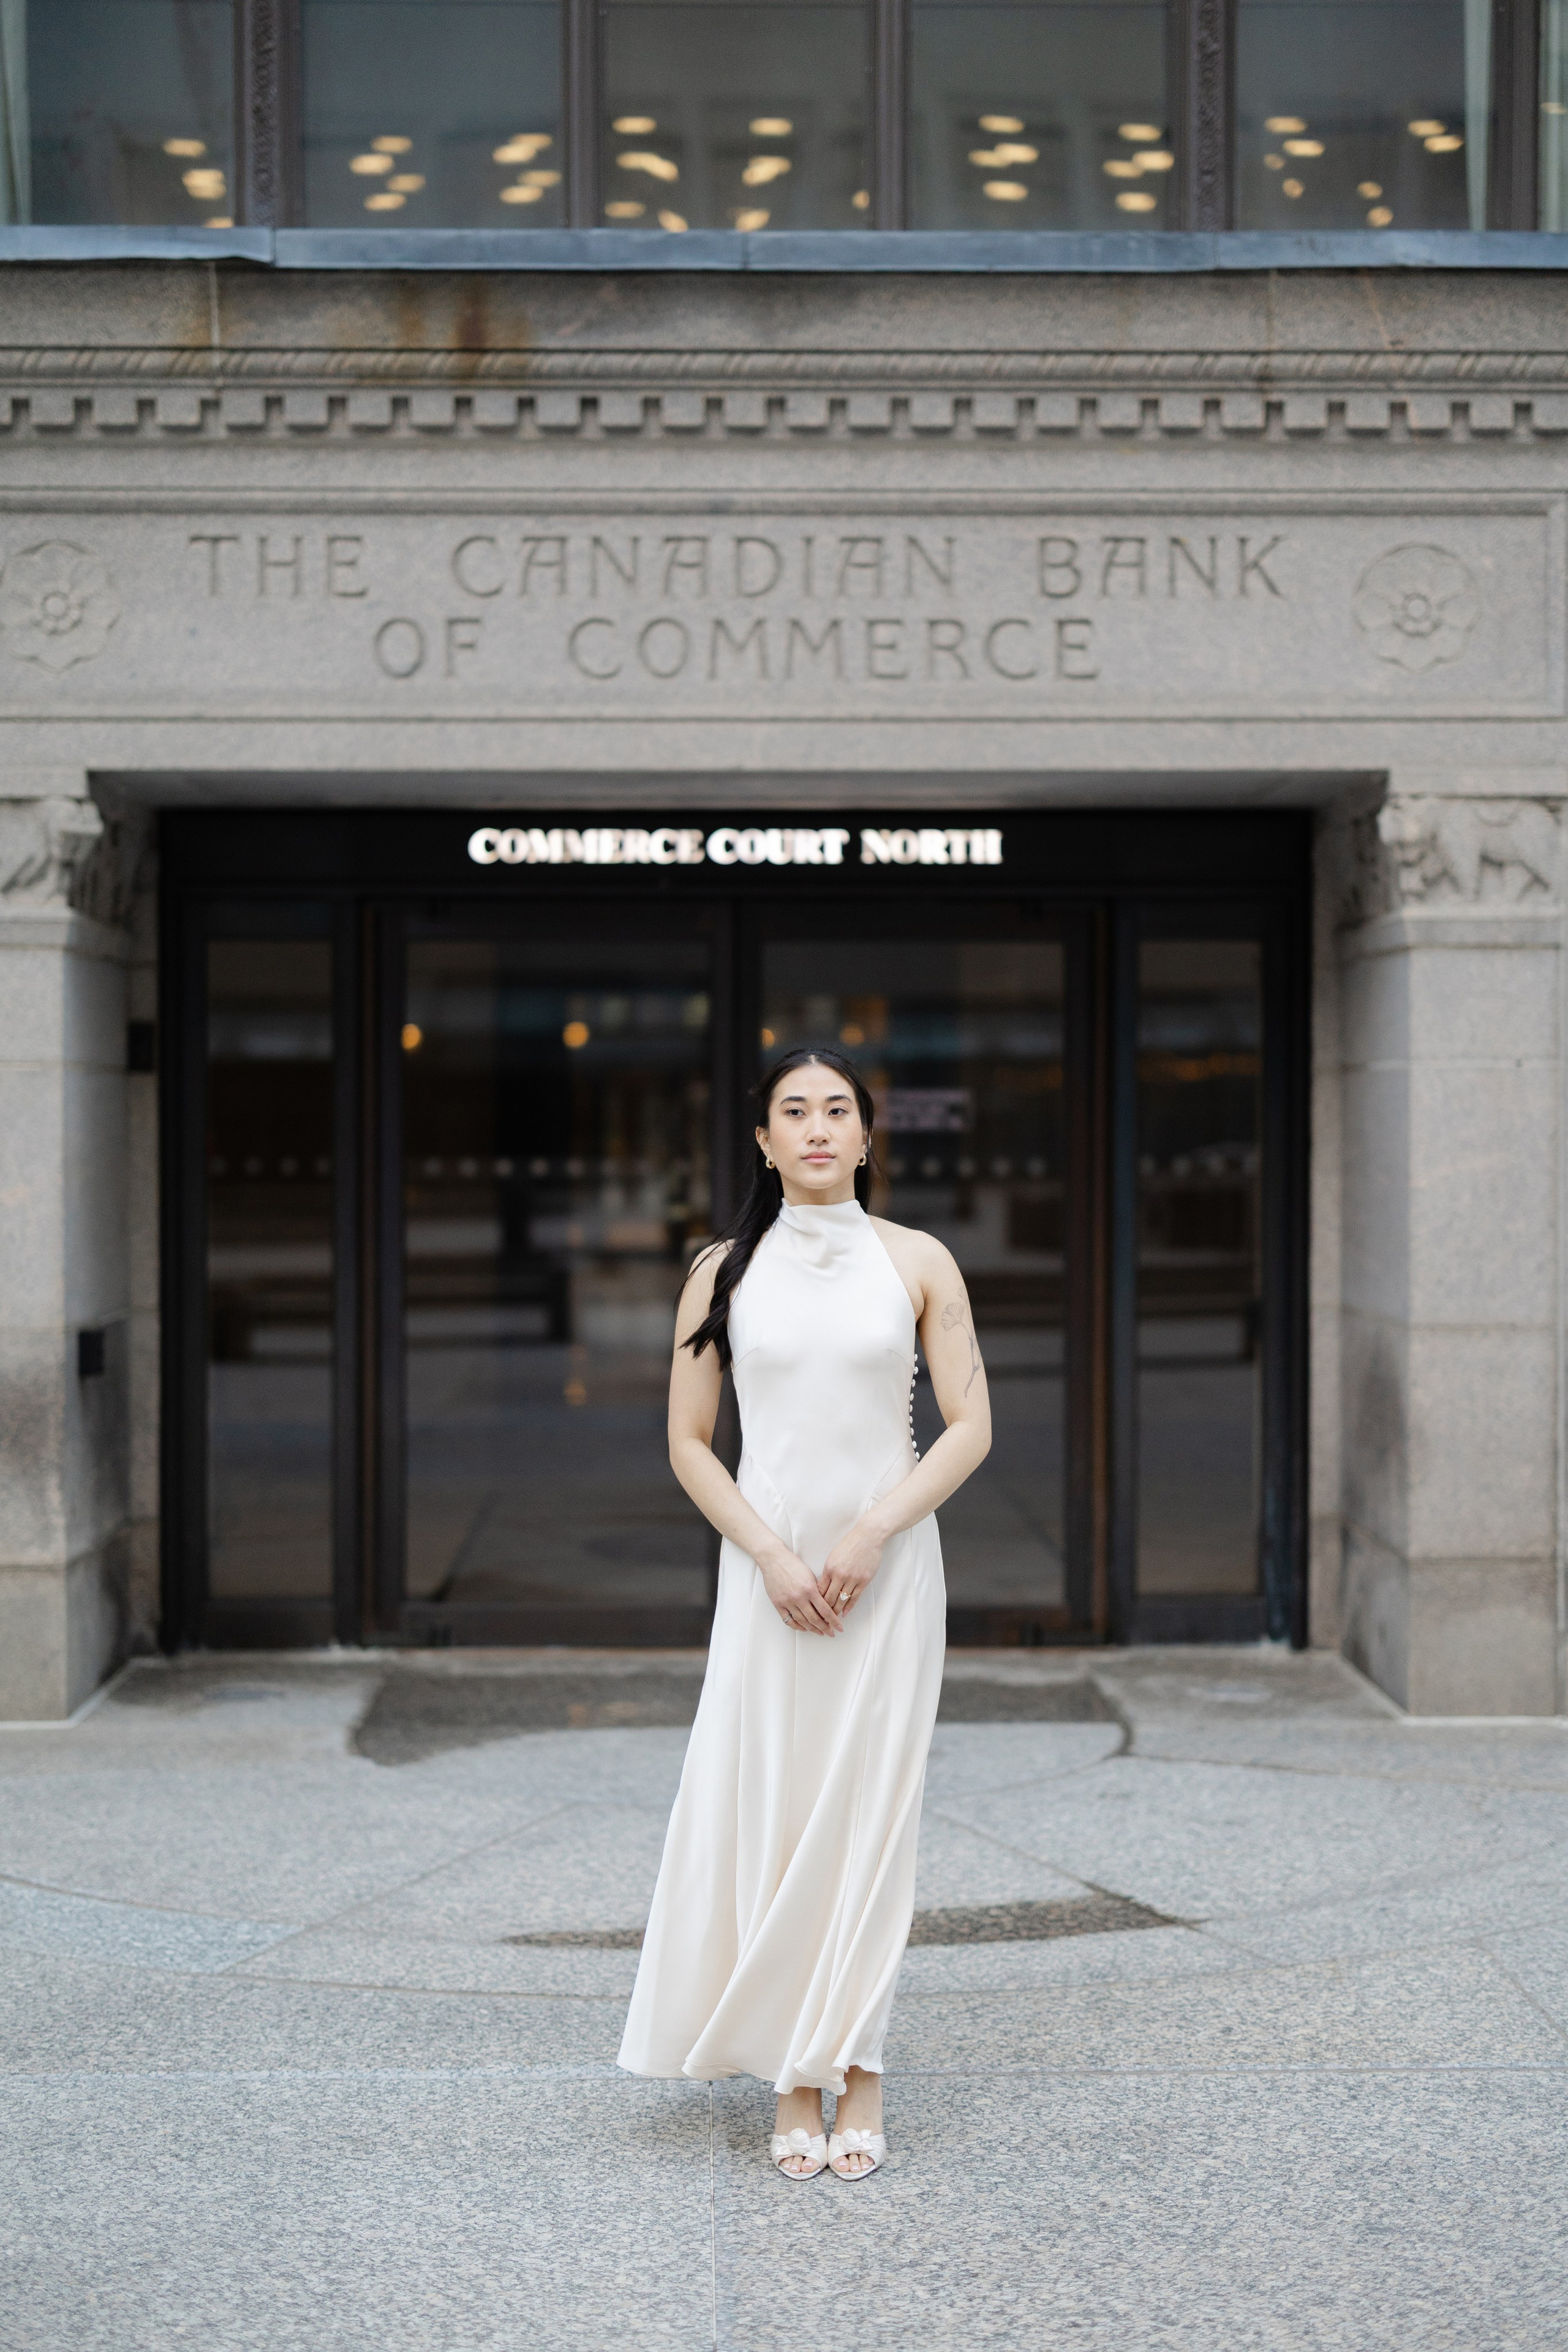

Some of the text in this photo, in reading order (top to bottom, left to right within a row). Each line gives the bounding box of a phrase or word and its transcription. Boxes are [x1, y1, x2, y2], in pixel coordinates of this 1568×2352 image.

[188, 533, 1289, 601] THE CANADIAN BANK
[373, 616, 1101, 682] OF COMMERCE
[467, 827, 1003, 865] COMMERCE COURT NORTH
